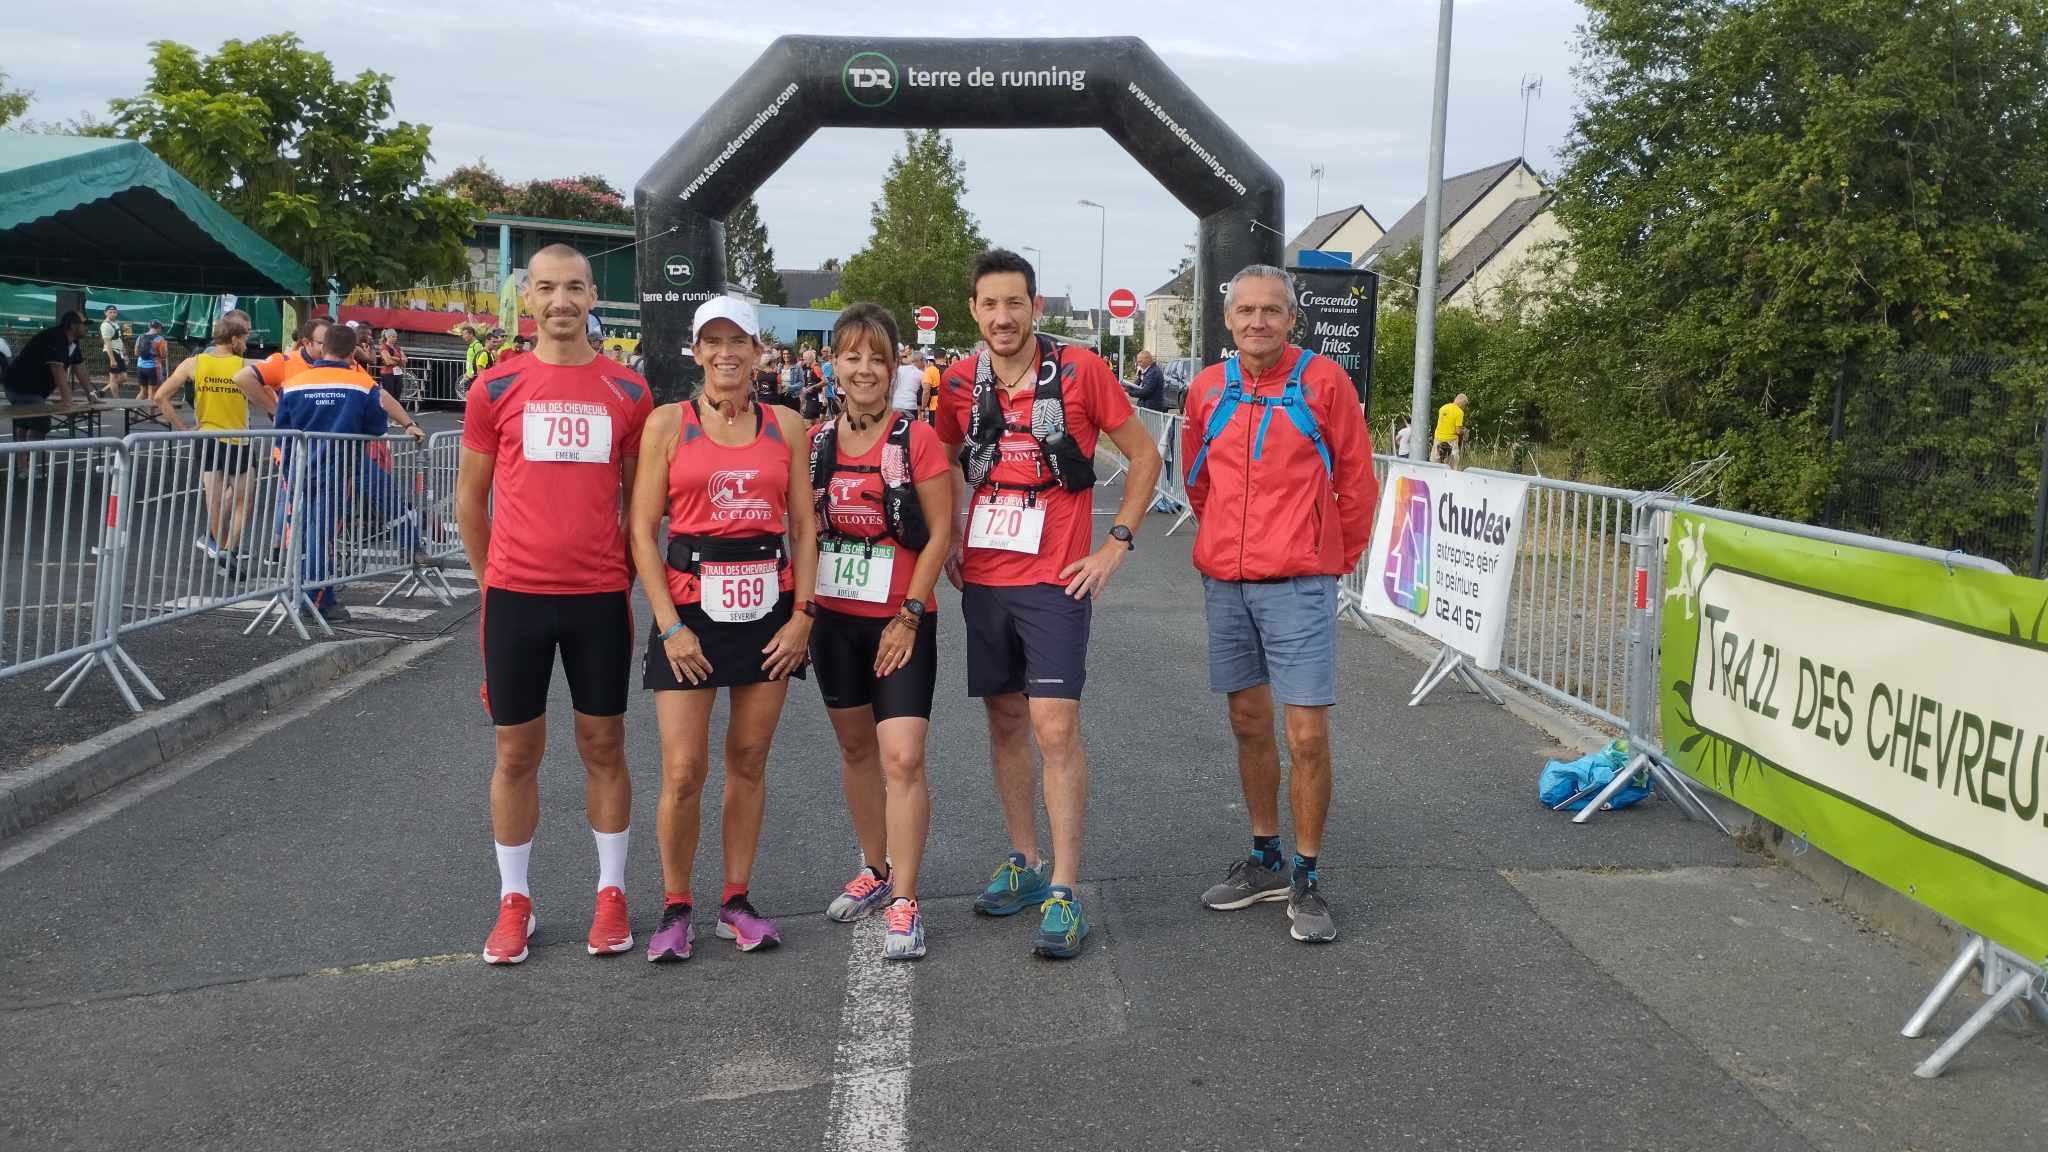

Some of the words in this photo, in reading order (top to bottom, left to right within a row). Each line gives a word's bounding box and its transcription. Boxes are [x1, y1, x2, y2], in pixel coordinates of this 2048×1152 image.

[848, 68, 893, 88] TDR
[908, 67, 961, 87] terre
[967, 66, 995, 87] de
[1002, 65, 1086, 91] running
[679, 82, 799, 201] www.terrederunning.com
[1127, 81, 1247, 196] www.terrederunning.com
[643, 291, 663, 302] terre
[665, 290, 680, 302] de
[1299, 291, 1358, 307] Crescendo
[1313, 321, 1360, 338] Moules
[1320, 336, 1351, 355] frites
[527, 402, 547, 413] TRAIL
[549, 403, 563, 413] DES
[564, 403, 608, 416] CHEVREUILS
[543, 416, 589, 448] 799
[710, 511, 728, 521] AC
[837, 514, 883, 525] CLOYES
[984, 508, 1023, 538] 720
[704, 565, 724, 575] TRAIL
[726, 566, 740, 576] DES
[741, 562, 777, 575] CHEVREUILS
[834, 557, 870, 588] 149
[721, 577, 764, 609] 569
[1445, 573, 1479, 599] peinture
[1435, 597, 1450, 621] 02
[1451, 604, 1462, 626] 41
[1465, 608, 1482, 633] 67
[1704, 604, 1781, 720] TRAIL
[1791, 656, 1855, 746] DES
[1866, 682, 2048, 828] CHEVREU
